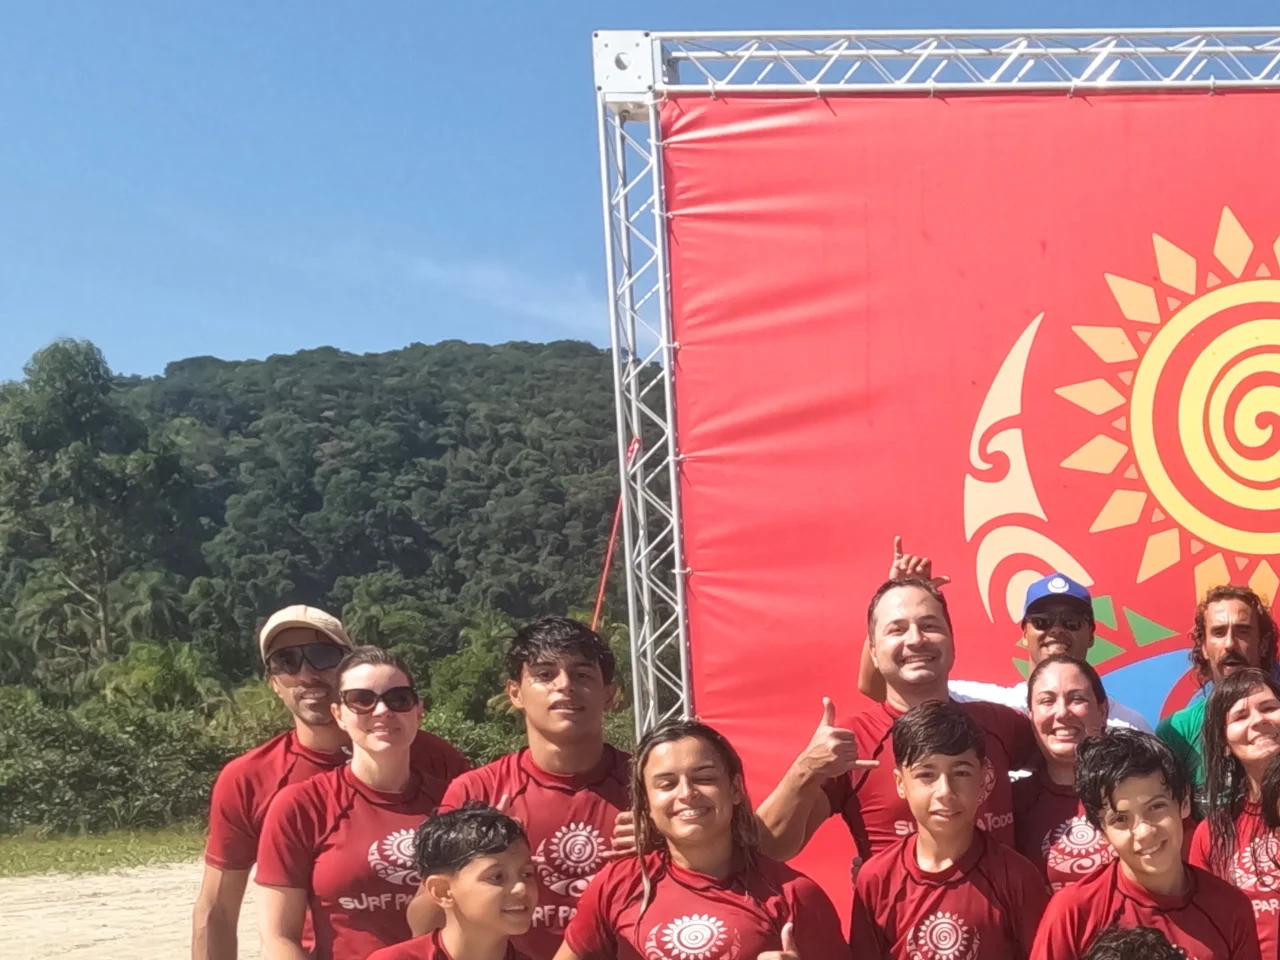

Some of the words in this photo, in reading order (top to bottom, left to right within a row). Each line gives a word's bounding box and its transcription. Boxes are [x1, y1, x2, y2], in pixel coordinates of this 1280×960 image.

[338, 892, 393, 912] SURF
[532, 905, 556, 928] RF
[558, 905, 578, 928] PA
